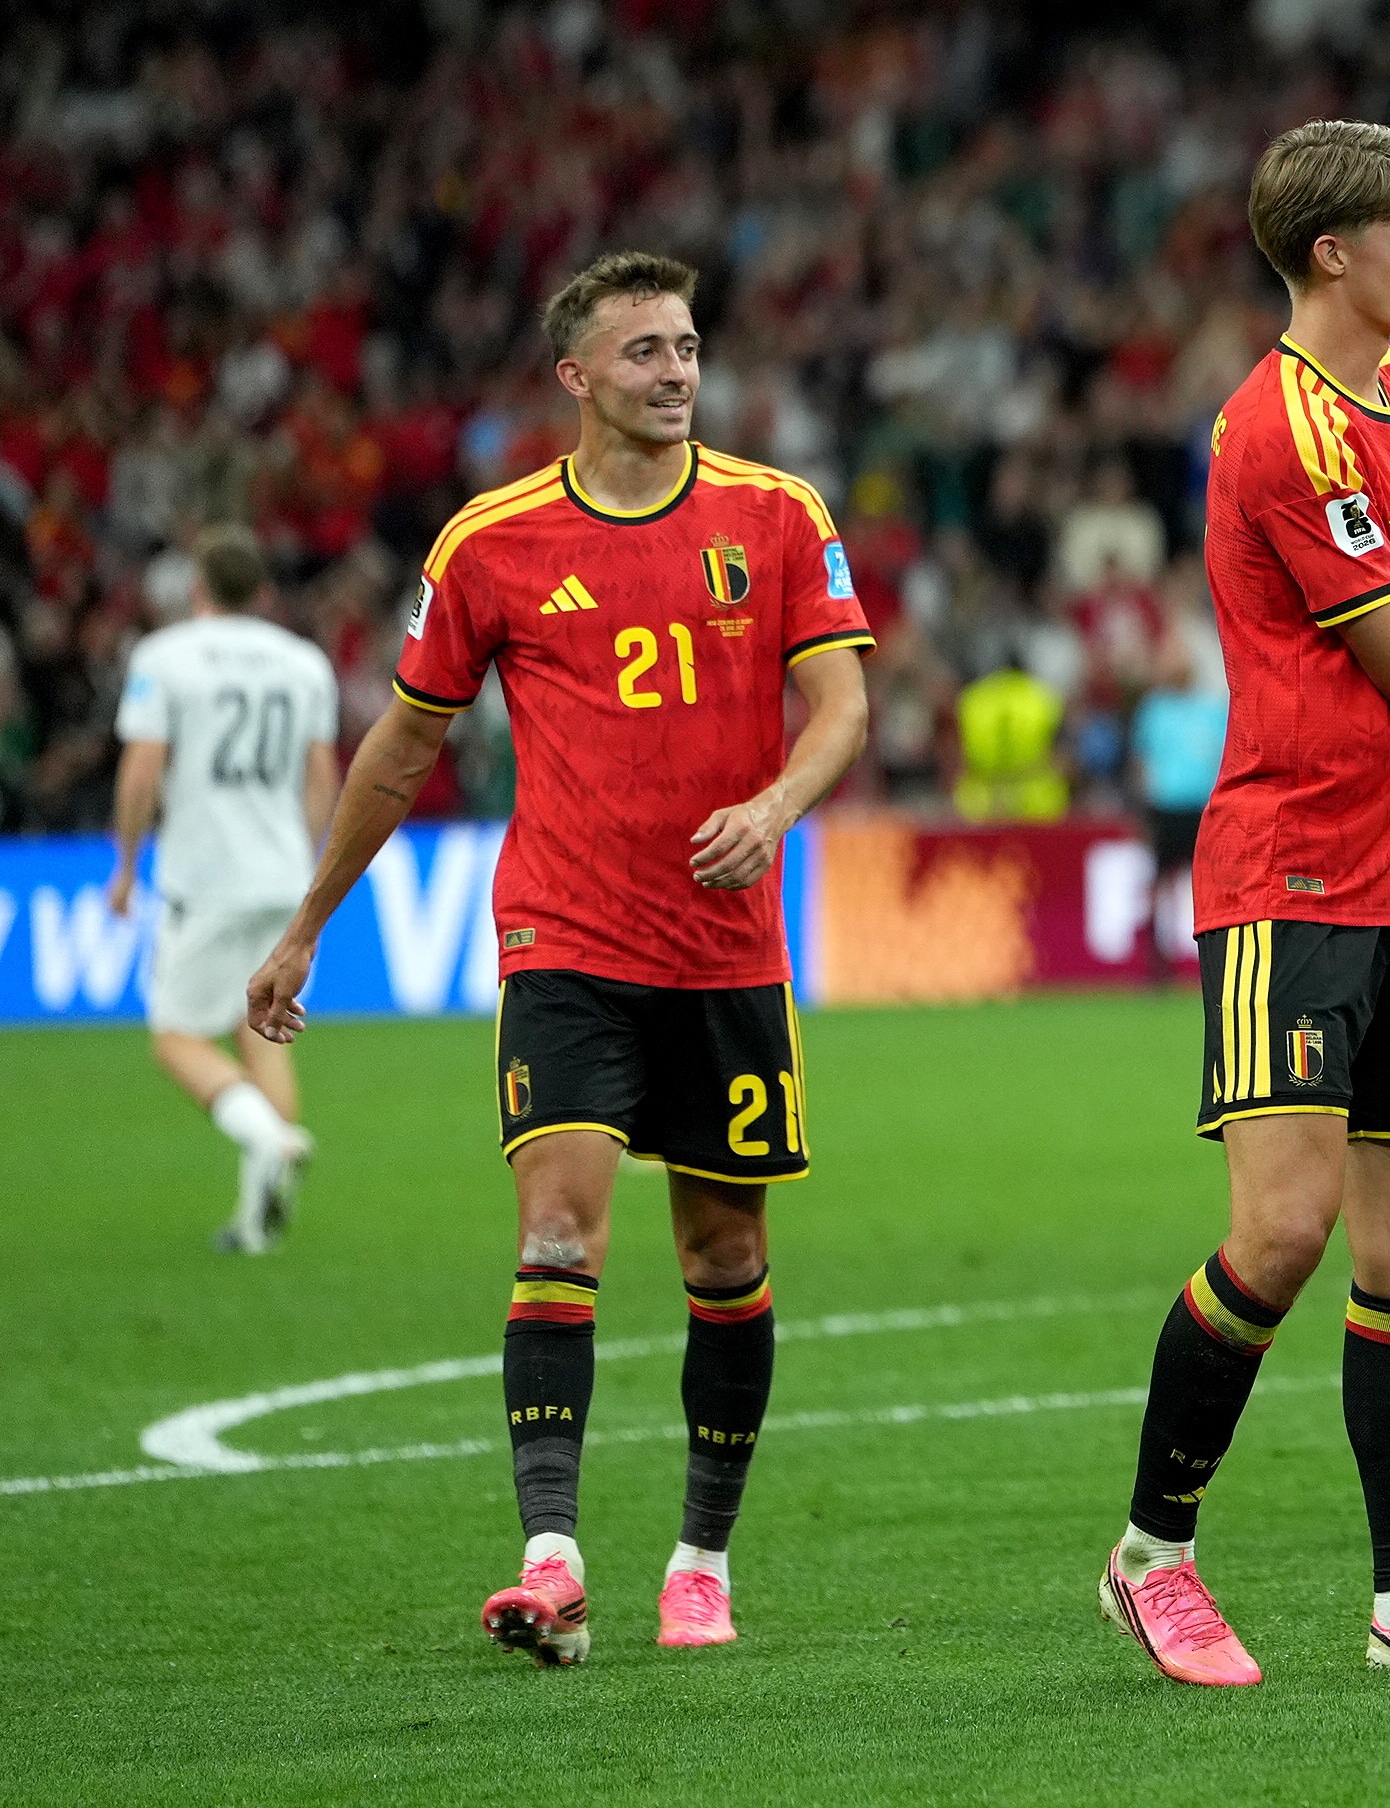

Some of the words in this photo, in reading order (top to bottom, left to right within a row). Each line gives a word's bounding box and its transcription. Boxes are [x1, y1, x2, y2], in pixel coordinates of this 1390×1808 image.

[1353, 538, 1376, 551] 2026
[614, 622, 697, 708] 21
[211, 684, 293, 787] 20
[728, 1071, 799, 1156] 21
[511, 1406, 573, 1426] RBFA
[697, 1425, 756, 1446] RBFA
